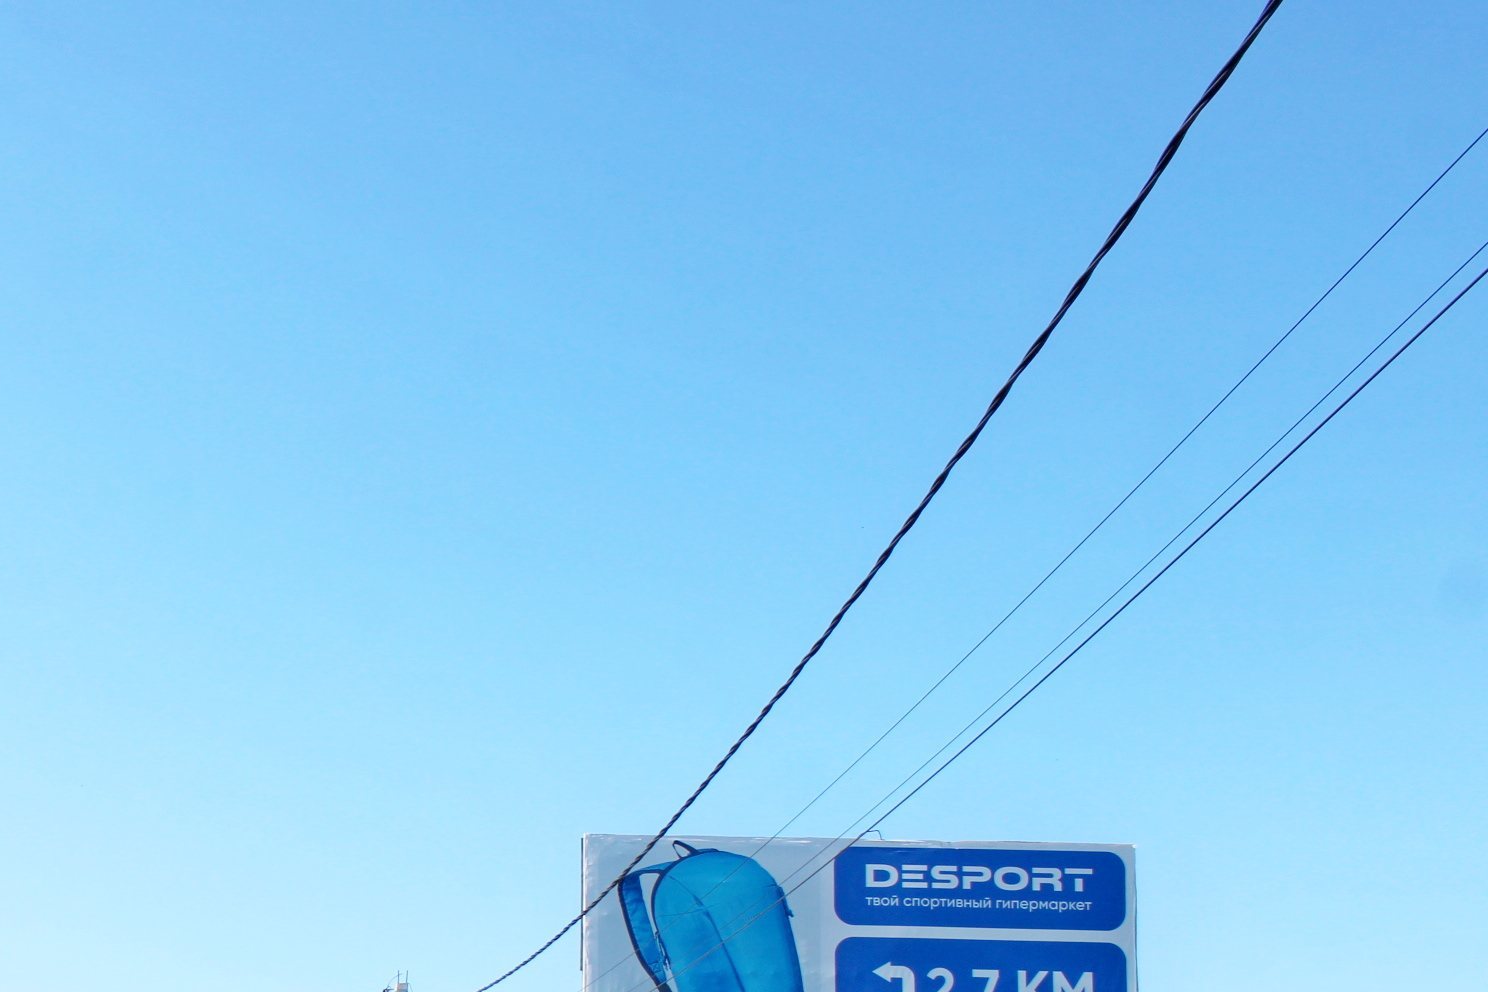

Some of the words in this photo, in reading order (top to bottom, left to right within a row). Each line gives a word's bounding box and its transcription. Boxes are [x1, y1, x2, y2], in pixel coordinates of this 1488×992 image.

[865, 863, 1093, 892] DESPORT
[865, 895, 899, 906] твой
[903, 896, 992, 910] спортивный
[995, 898, 1093, 912] гипермаркет
